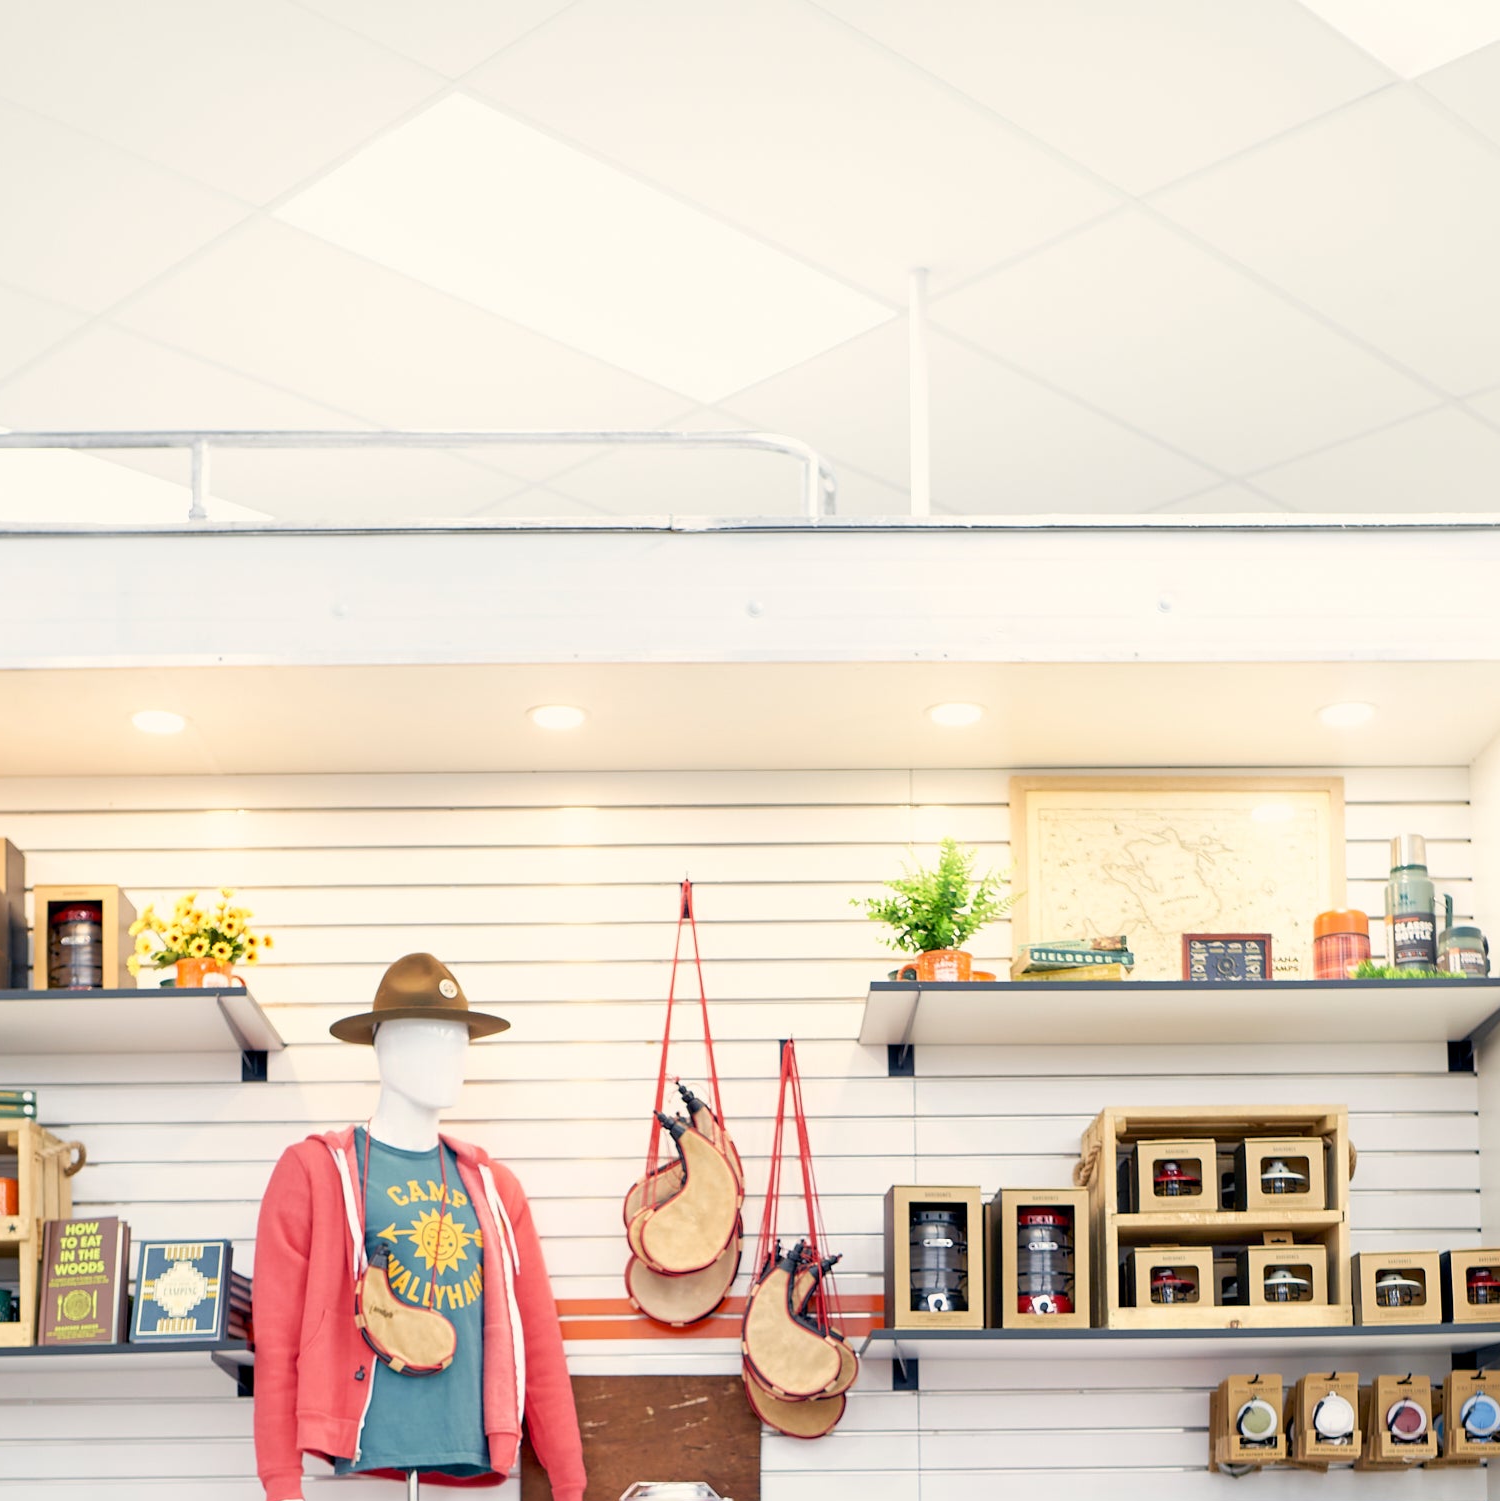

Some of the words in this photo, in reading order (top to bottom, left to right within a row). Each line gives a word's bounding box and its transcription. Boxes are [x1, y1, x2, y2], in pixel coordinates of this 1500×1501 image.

[387, 1180, 468, 1208] CAMP
[65, 1222, 99, 1236] HOW
[60, 1237, 78, 1249] TO
[80, 1235, 103, 1248] EAT
[60, 1251, 76, 1263] IN
[78, 1249, 101, 1261] THE
[55, 1261, 105, 1276] WOODS
